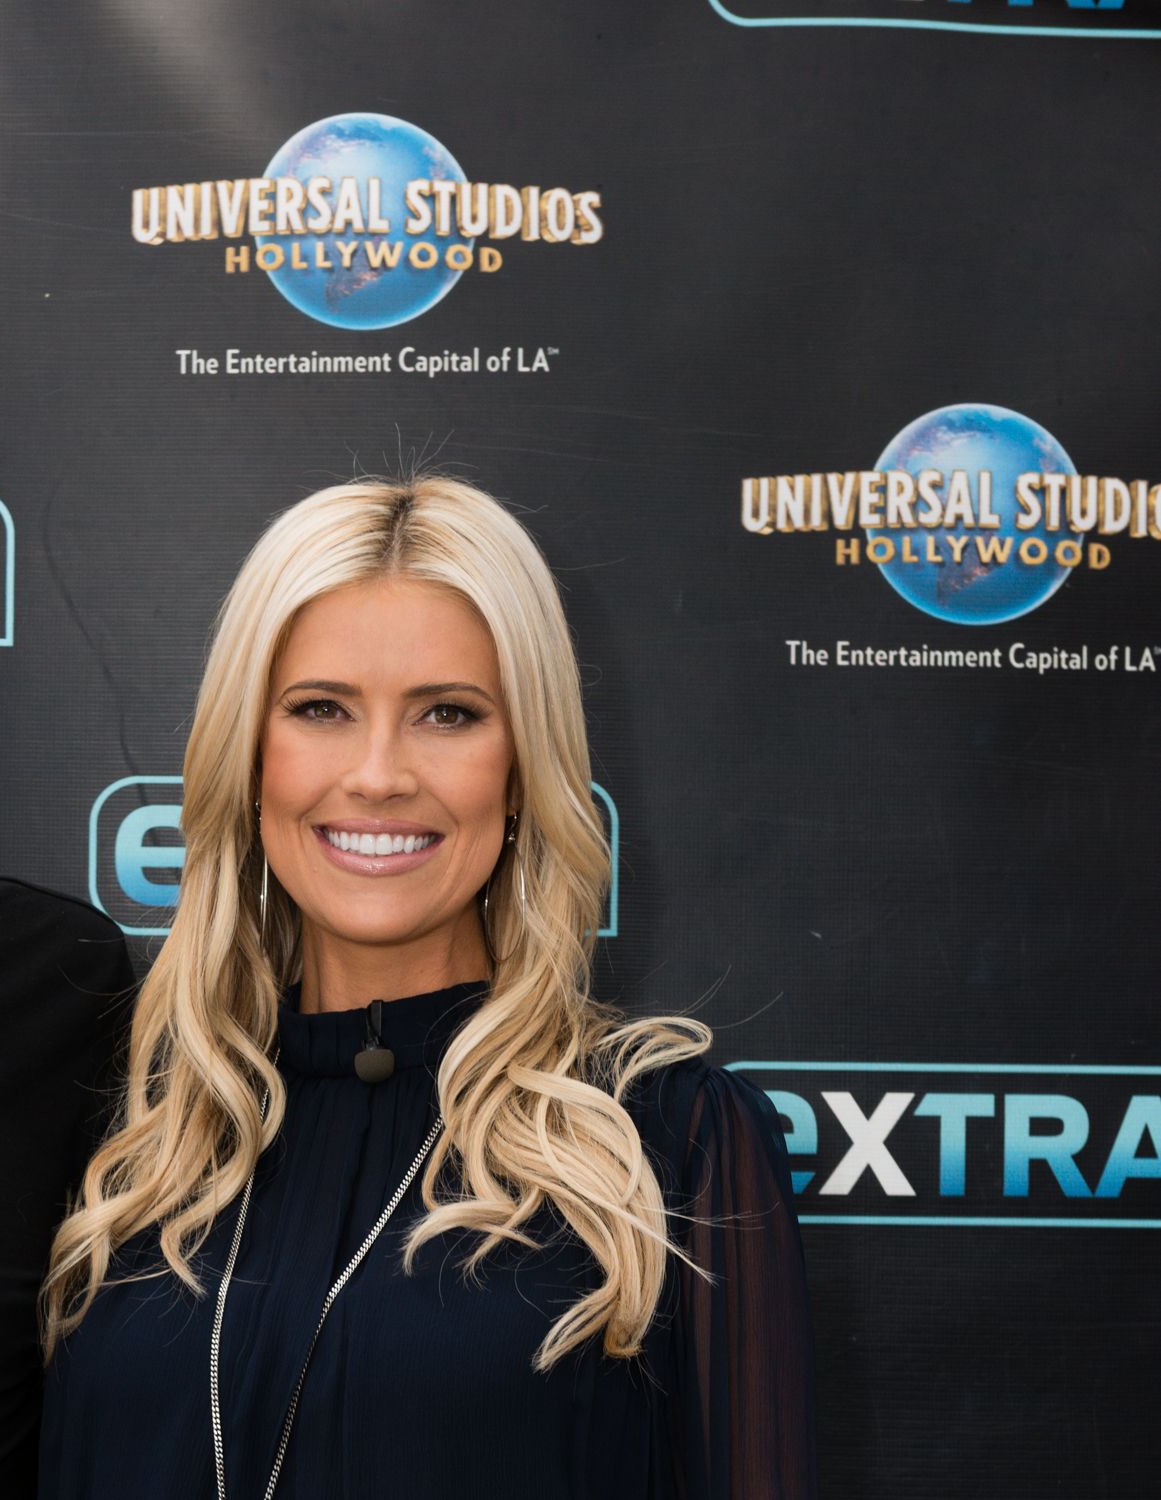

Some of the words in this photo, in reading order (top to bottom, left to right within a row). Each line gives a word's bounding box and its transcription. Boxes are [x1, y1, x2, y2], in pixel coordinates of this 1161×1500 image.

[131, 176, 391, 246] UNIVERSAL
[405, 178, 604, 246] STUDIOS
[224, 240, 504, 275] HOLLYWOOD
[176, 349, 219, 374] The
[226, 349, 391, 374] Entertainment
[398, 346, 480, 378] Capital
[486, 347, 511, 373] of
[742, 469, 1001, 535] UNIVERSAL
[835, 535, 1111, 571] HOLLYWOOD
[786, 640, 829, 666] The
[836, 640, 1002, 668] Entertainment
[1008, 642, 1088, 675] Capital
[1094, 645, 1119, 671] of
